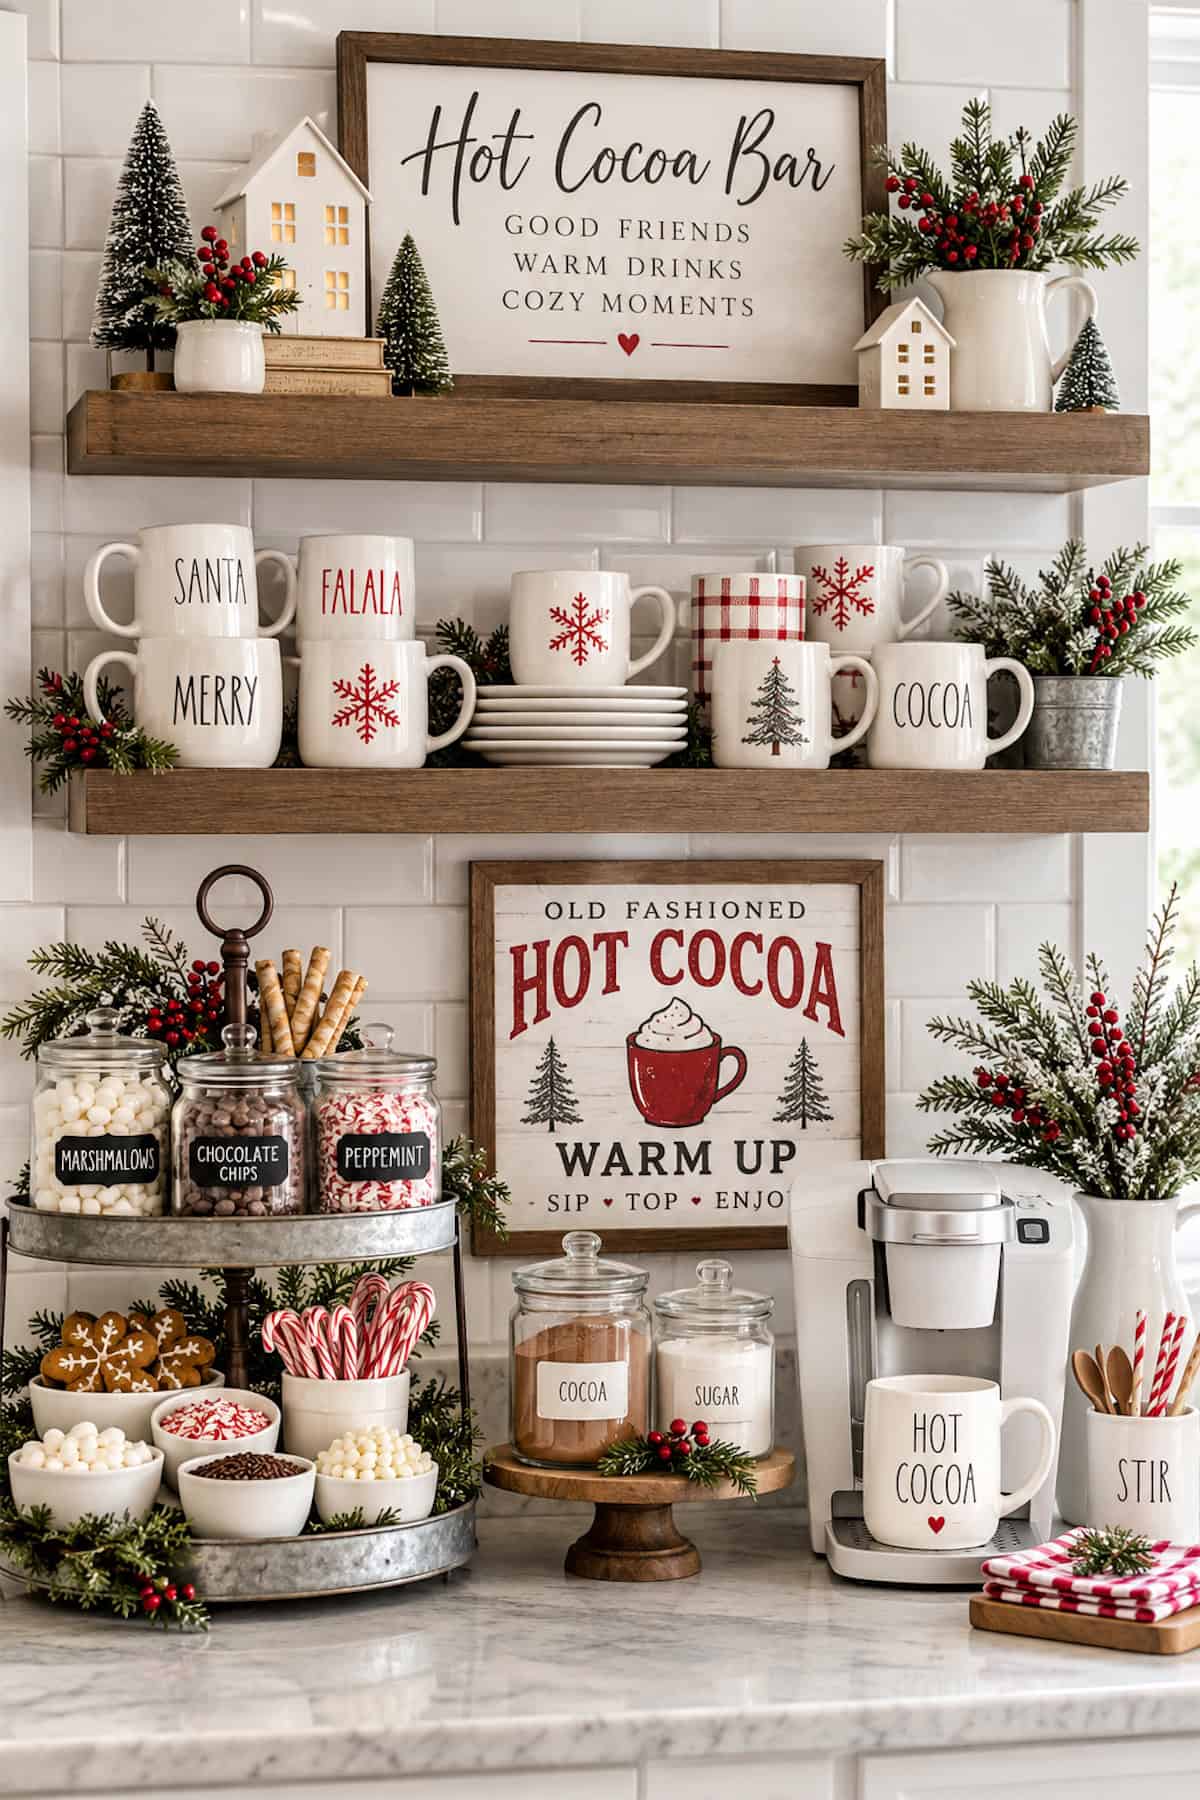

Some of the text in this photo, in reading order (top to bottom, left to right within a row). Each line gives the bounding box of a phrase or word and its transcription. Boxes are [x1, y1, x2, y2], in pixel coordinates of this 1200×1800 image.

[401, 92, 835, 226] Hot Cocoa Bar
[504, 214, 750, 243] GOOD FRIENDS
[514, 252, 742, 280] WARM DRINKS
[502, 290, 753, 317] COZY MOMENTS
[174, 557, 247, 606] SANTA
[322, 569, 402, 615] FALALA
[173, 675, 257, 725] MERRY
[893, 681, 972, 729] COCOA
[544, 900, 806, 920] OLD FASHIONED
[509, 929, 845, 1040] HOT COCOA
[61, 1148, 154, 1172] MARSHMALOWS
[197, 1145, 280, 1164] CHOCOLATE
[345, 1144, 425, 1169] PEPPEMINT
[556, 1140, 796, 1176] WARM UP
[219, 1165, 258, 1182] CHIPS
[547, 1190, 790, 1213] SIP TOP ENJO
[558, 1380, 607, 1403] COCOA
[694, 1385, 739, 1407] SUGAR
[914, 1413, 962, 1453] HOT
[896, 1462, 976, 1504] COCOA
[1117, 1459, 1171, 1503] STIR
